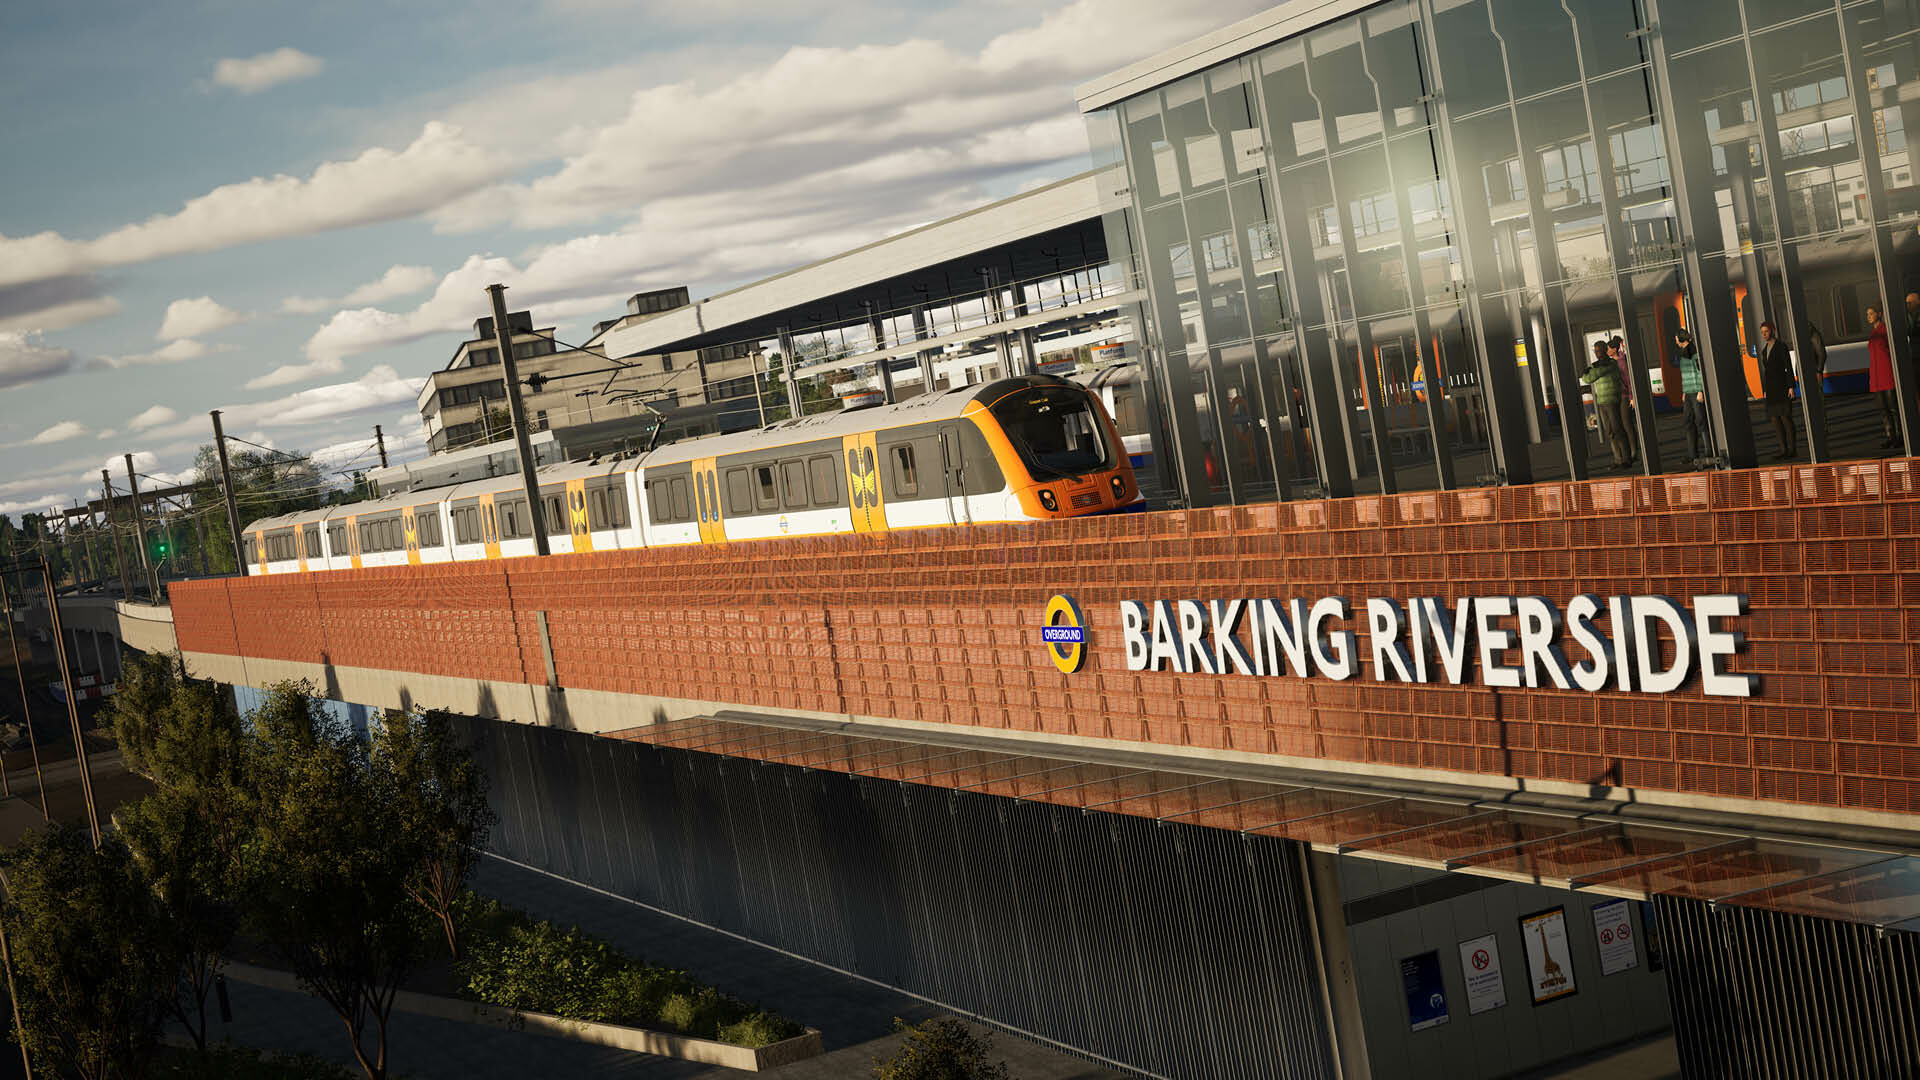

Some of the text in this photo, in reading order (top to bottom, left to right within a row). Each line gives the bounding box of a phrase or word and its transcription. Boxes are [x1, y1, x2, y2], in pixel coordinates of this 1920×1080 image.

[1044, 629, 1081, 640] OVERGROUND
[1120, 595, 1753, 697] BARKING RIVERSIDE
